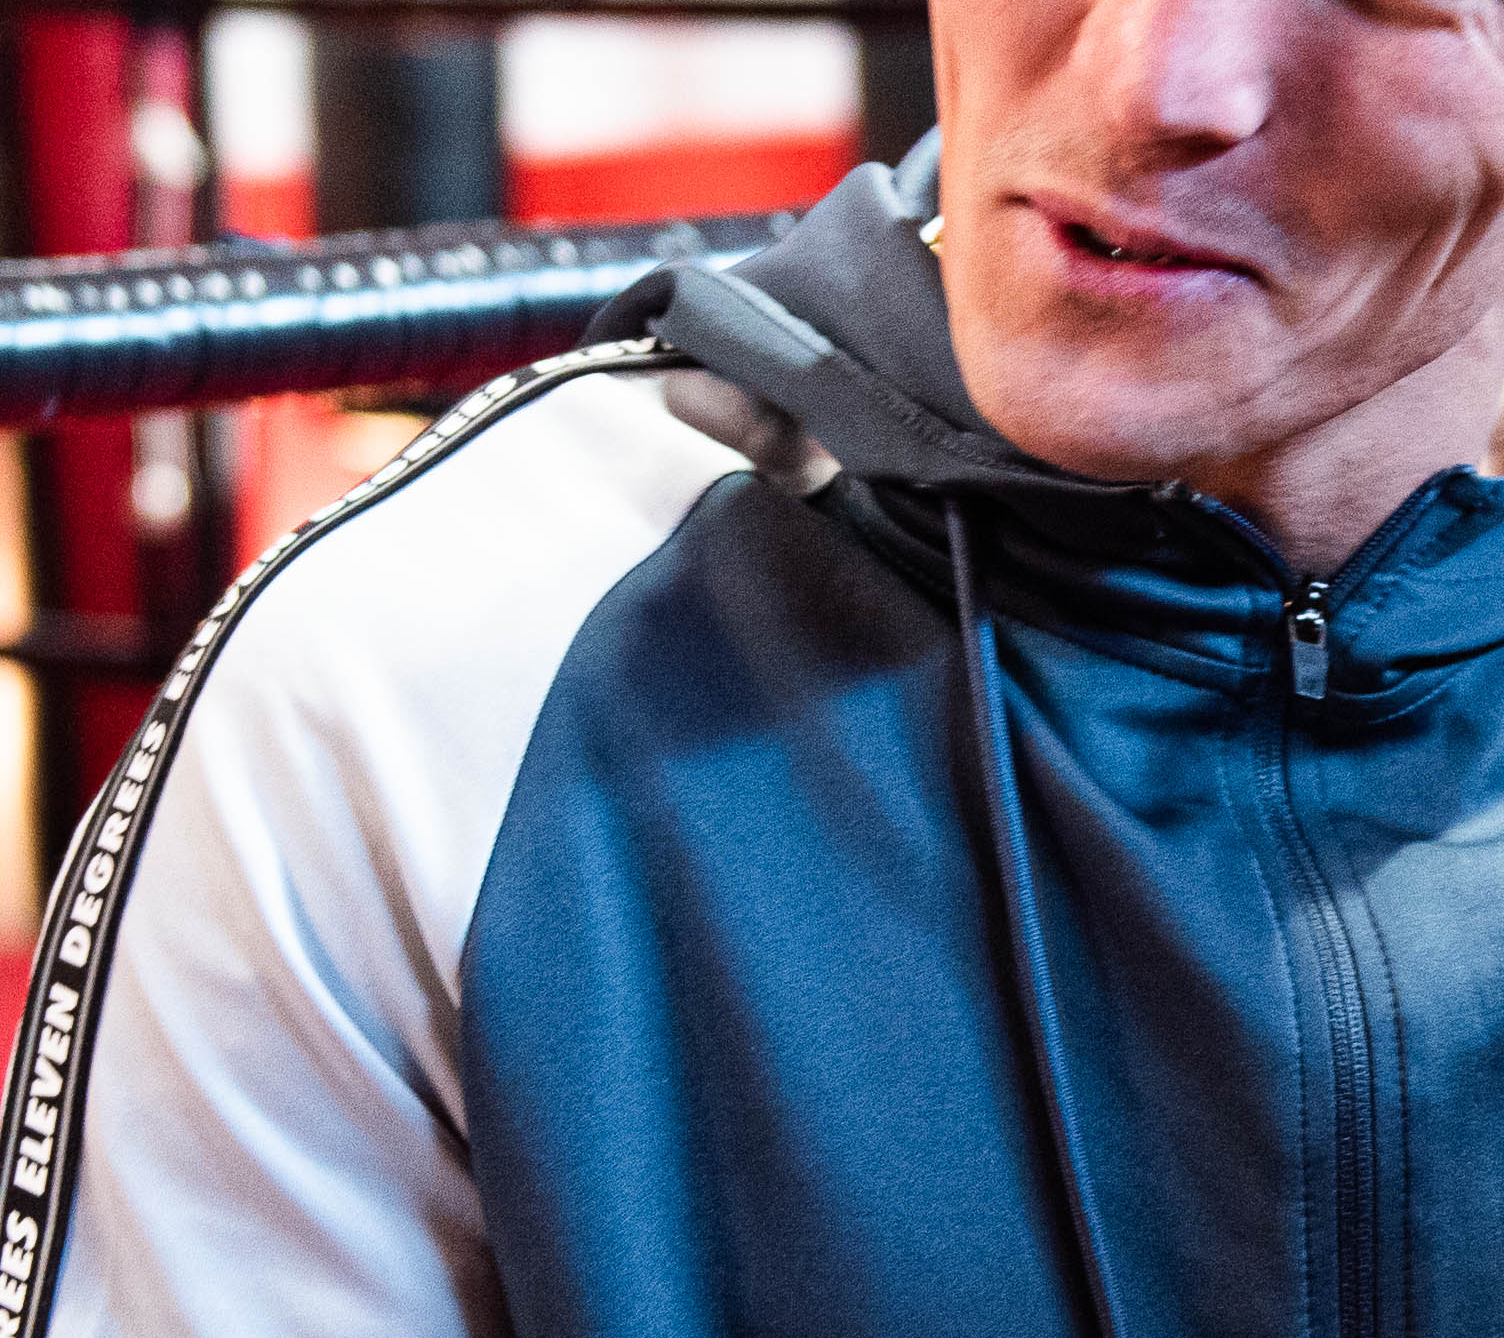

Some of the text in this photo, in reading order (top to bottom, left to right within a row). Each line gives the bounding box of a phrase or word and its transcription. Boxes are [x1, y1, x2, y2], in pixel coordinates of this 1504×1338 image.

[13, 982, 80, 1198] ELEVEN
[58, 719, 166, 967] DEGREES
[163, 531, 300, 702] ELEVEN
